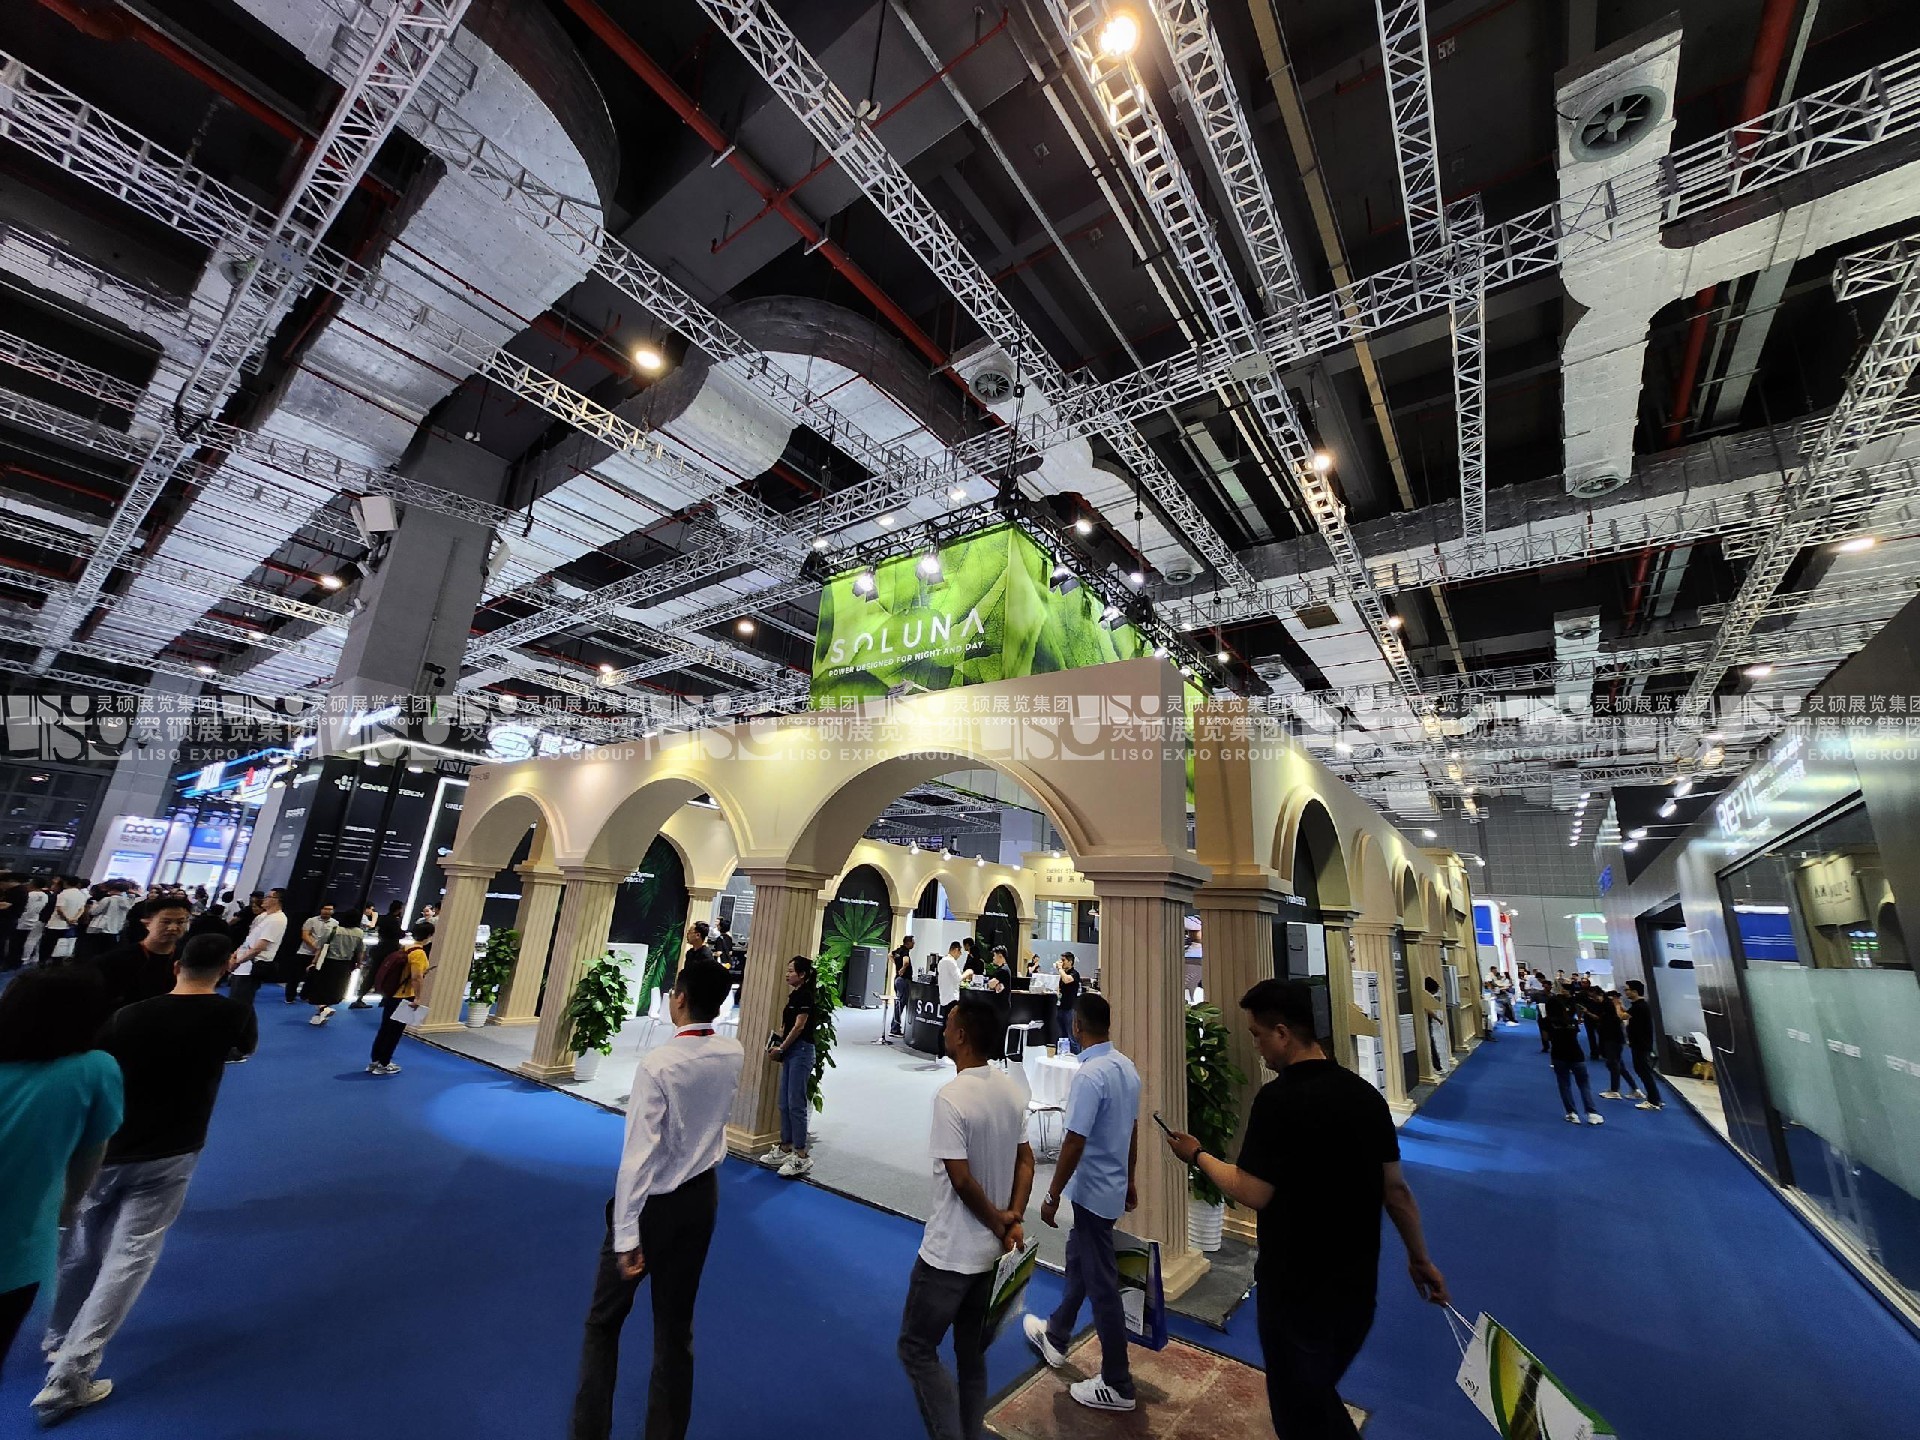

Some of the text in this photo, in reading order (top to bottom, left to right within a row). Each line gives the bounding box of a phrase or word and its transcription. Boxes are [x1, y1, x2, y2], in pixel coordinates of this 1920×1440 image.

[828, 641, 985, 677] POWER DESIGNED FOR NIGHT AND DAY
[830, 608, 985, 664] SOLUNA
